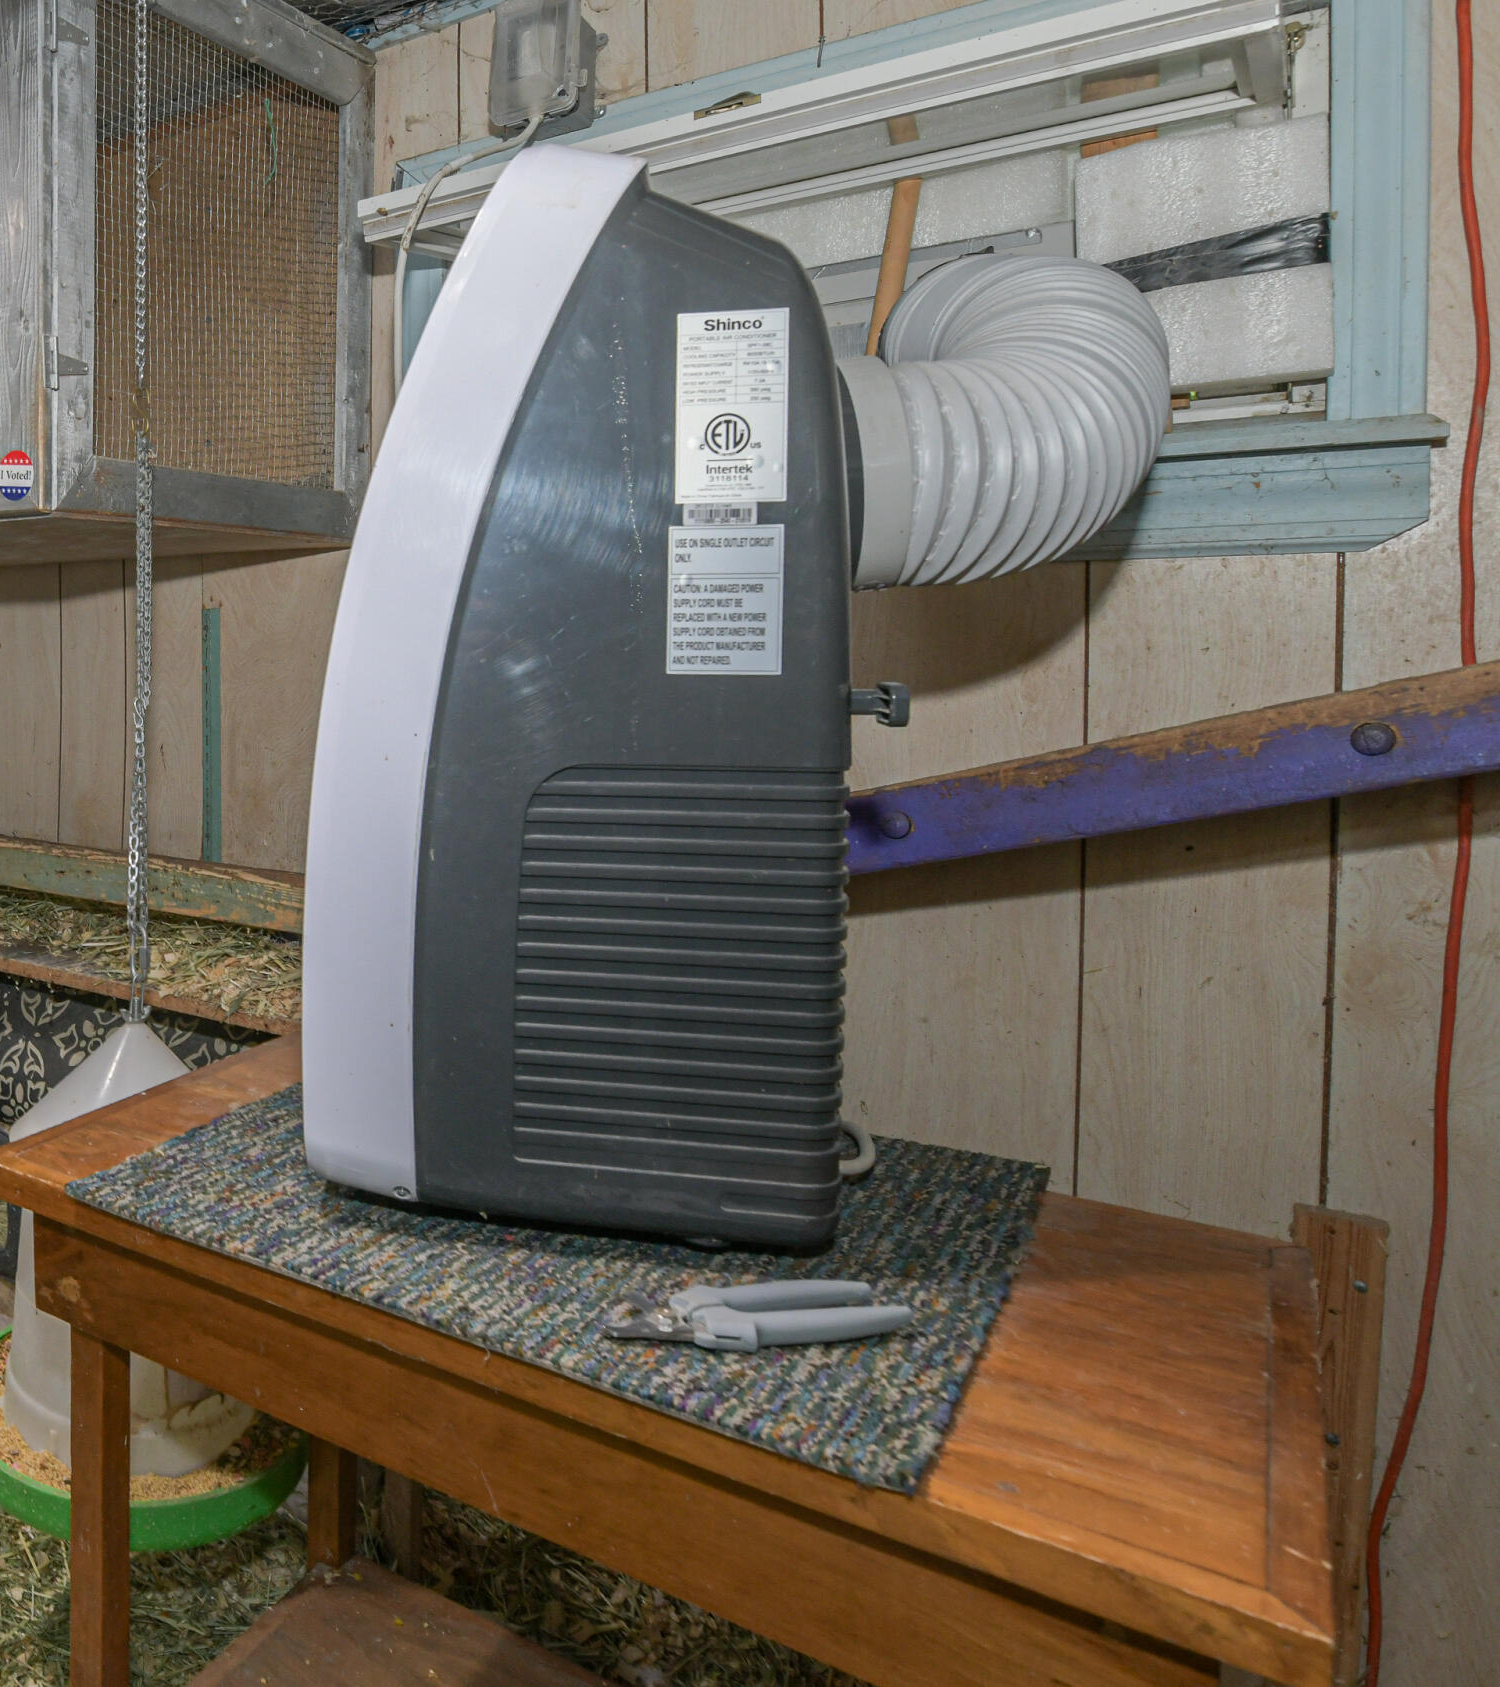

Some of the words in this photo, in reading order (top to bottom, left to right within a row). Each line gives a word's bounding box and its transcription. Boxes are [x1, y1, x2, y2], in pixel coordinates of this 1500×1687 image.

[704, 317, 763, 331] Shinco
[705, 464, 753, 474] Intertek
[0, 470, 4, 480] I
[6, 470, 32, 480] Voted!
[675, 538, 688, 548] USE
[689, 538, 698, 548] ON
[699, 538, 722, 548] SINGLE
[723, 537, 748, 548] OUTLET
[749, 537, 775, 547] CIRCUIT
[703, 584, 708, 593] A
[709, 584, 740, 593] DAMAGED
[741, 584, 764, 593] POWER
[673, 598, 696, 608] SUPPLY
[698, 598, 715, 608] CORD
[716, 598, 733, 607] MUST
[734, 598, 743, 608] BE
[673, 612, 705, 622] REPLACED
[706, 612, 721, 622] WITH
[723, 612, 727, 621] A
[728, 612, 742, 622] NEW
[743, 612, 767, 622] POWER
[673, 627, 696, 636] SUPPLY
[697, 627, 714, 636] CORD
[716, 627, 746, 636] OBTAINED
[747, 627, 766, 636] FROM
[672, 641, 684, 651] THE
[685, 641, 714, 651] PRODUCT
[715, 641, 766, 651] MANUFACTURER
[672, 655, 685, 665] AND
[686, 655, 699, 665] NOT
